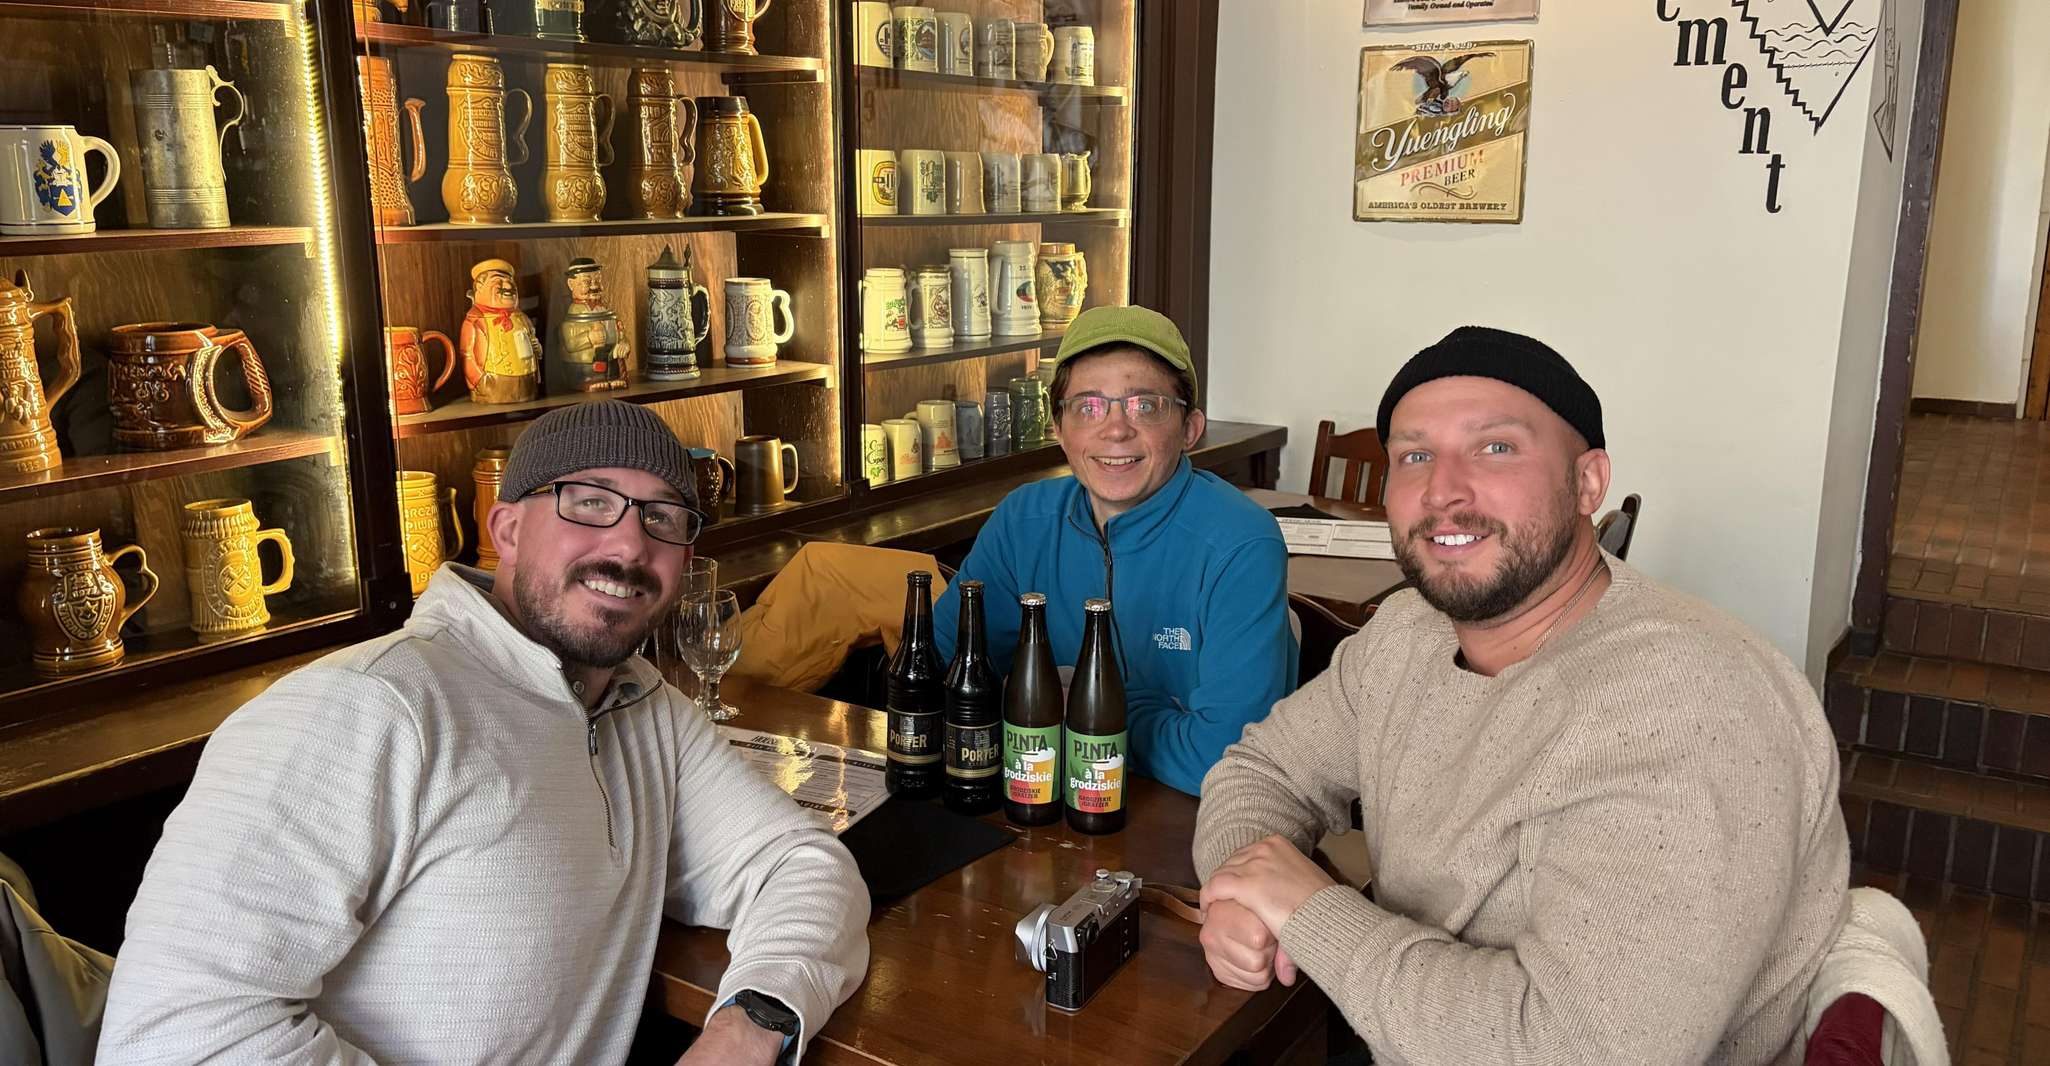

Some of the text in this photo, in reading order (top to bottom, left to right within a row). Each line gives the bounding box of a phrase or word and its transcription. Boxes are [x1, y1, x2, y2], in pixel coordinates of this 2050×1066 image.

[1371, 92, 1516, 172] Yuengling
[1400, 150, 1485, 187] PREMIUM
[1444, 169, 1476, 187] BEER
[1368, 202, 1508, 211] AMERICA'S OLDEST BREWERY
[1152, 633, 1180, 642] NORTH
[1163, 627, 1180, 636] THE
[1158, 642, 1180, 650] FACE
[890, 728, 928, 748] PORTER
[1006, 730, 1048, 752] PINTA
[961, 743, 999, 762] PORTER
[1074, 739, 1119, 760] PINTA
[1015, 759, 1034, 772] à la
[1004, 767, 1052, 783] grodziskie
[1085, 769, 1105, 780] à la
[1070, 777, 1121, 791] grodziskie
